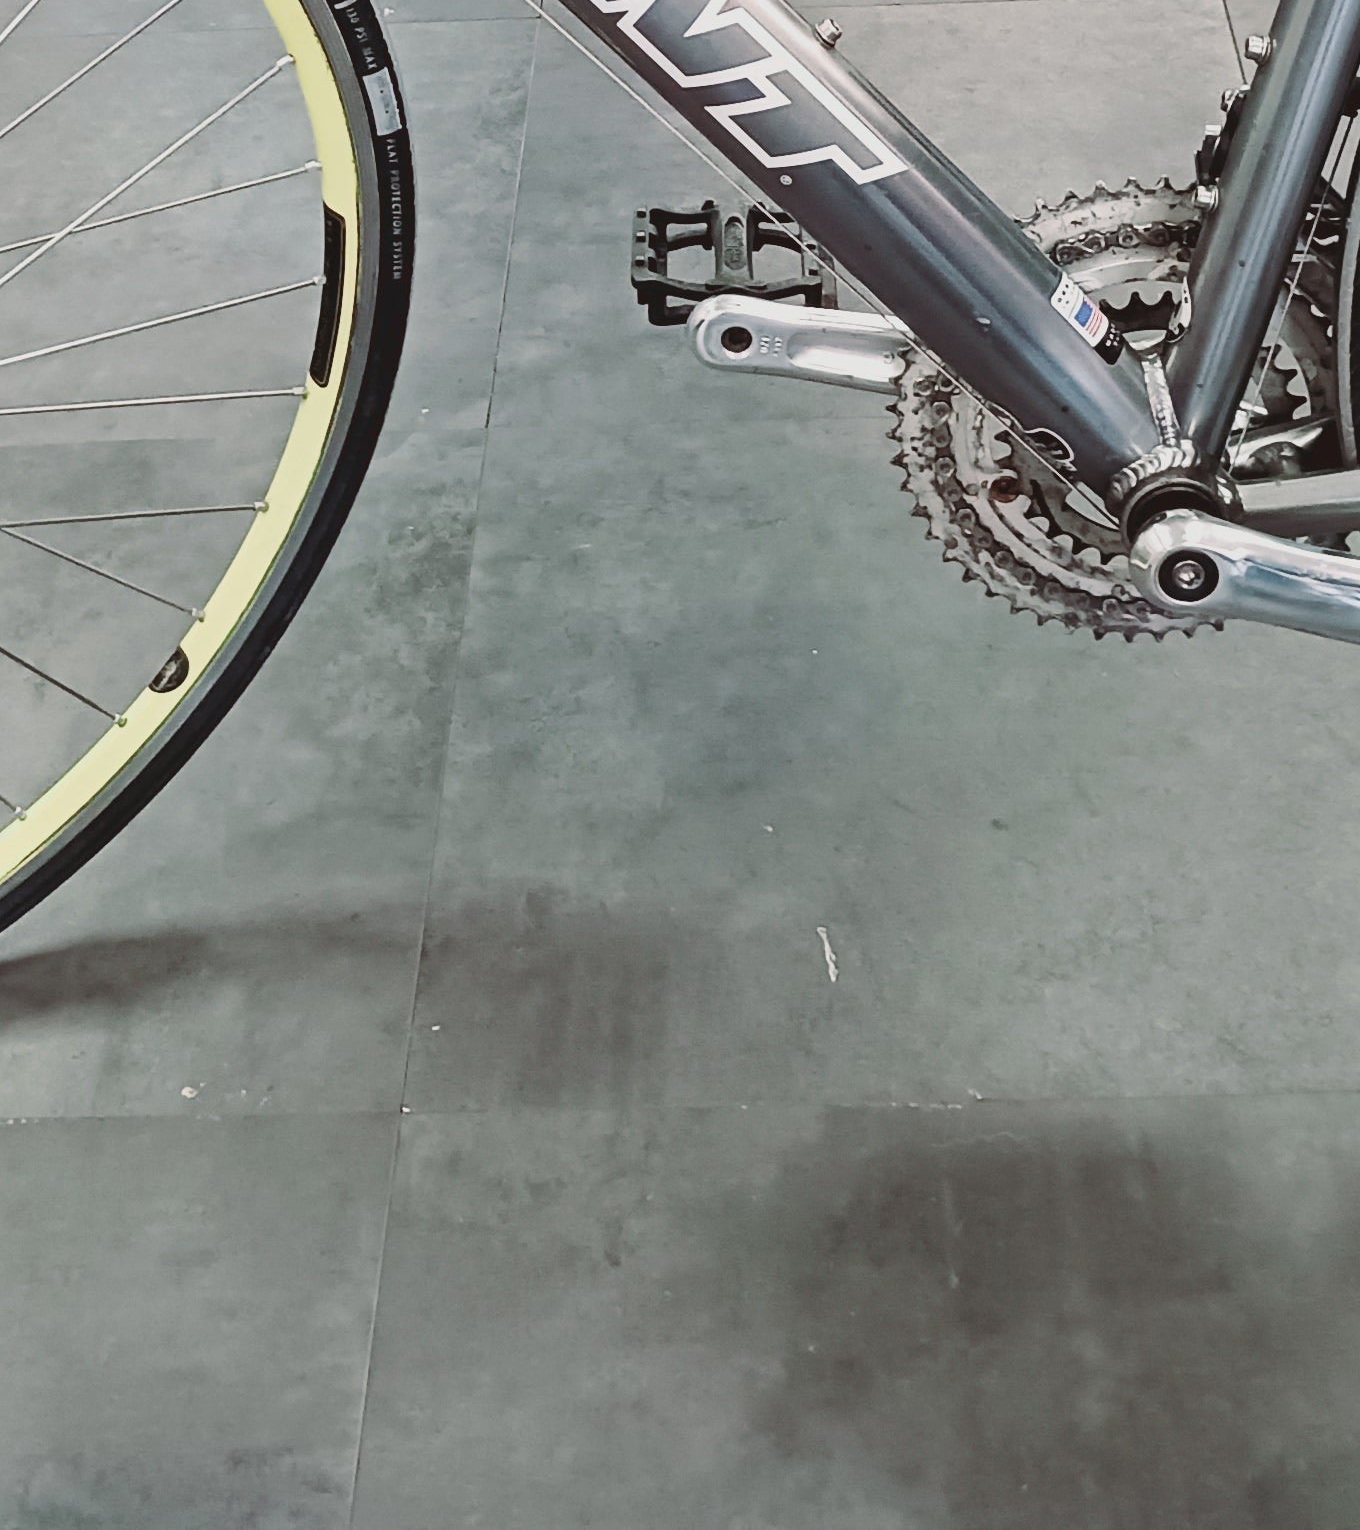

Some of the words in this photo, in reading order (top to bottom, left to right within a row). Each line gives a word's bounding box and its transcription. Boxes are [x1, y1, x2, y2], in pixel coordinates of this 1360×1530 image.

[354, 26, 369, 43] PSI
[362, 46, 378, 70] MAX
[385, 138, 399, 164] FLAT
[389, 169, 403, 236] PROTECTION
